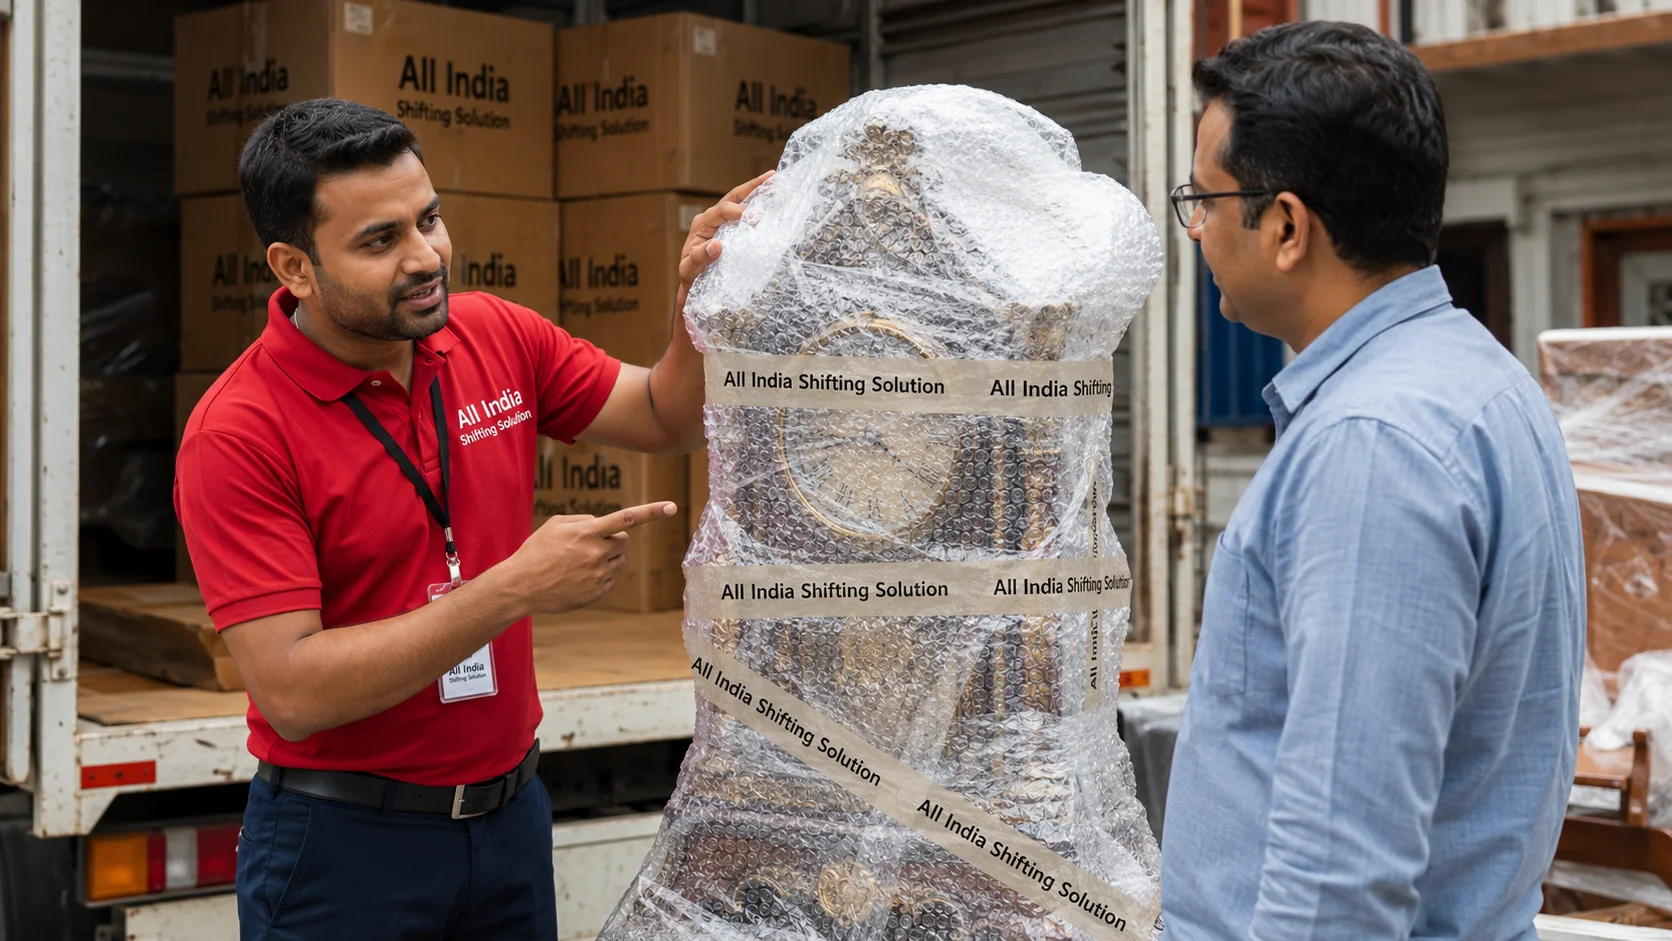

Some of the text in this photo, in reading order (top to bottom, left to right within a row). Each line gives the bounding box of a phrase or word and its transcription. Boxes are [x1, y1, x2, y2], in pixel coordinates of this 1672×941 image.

[240, 58, 288, 96] India
[398, 55, 510, 103] All India
[555, 75, 649, 116] All India
[735, 79, 764, 114] All
[397, 101, 511, 131] Shifting Solution
[211, 253, 238, 286] All
[461, 252, 517, 287] India
[588, 253, 638, 289] India
[723, 370, 945, 397] All India Shifting Solution
[989, 379, 1112, 398] All India Shifting
[457, 388, 523, 429] All India
[460, 410, 532, 446] Shifting Solution
[534, 452, 621, 491] ll India
[721, 579, 949, 603] All India Shifting Solution
[993, 578, 1018, 597] All
[1024, 576, 1063, 595] India
[1067, 576, 1102, 595] Shifting
[463, 662, 484, 673] India
[691, 656, 881, 787] All India Shifting Solution
[916, 799, 1126, 932] All India Shifting Solution
